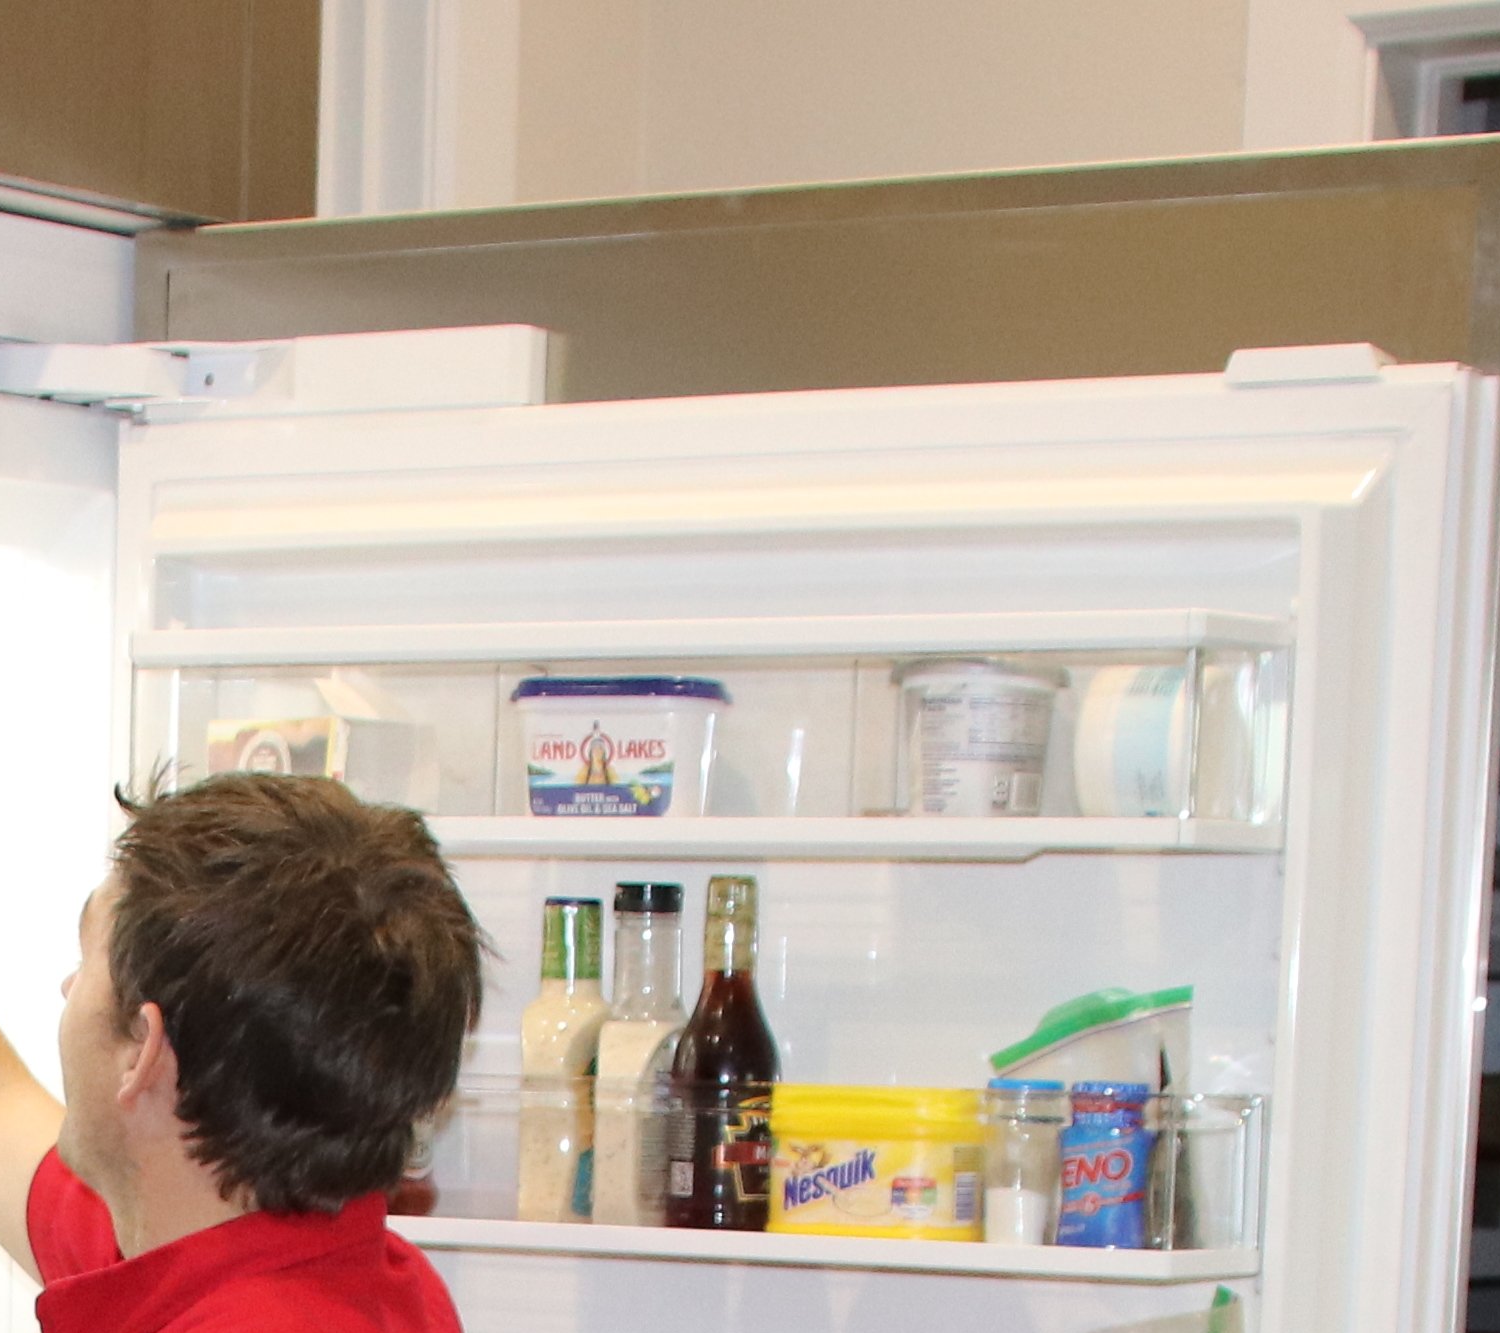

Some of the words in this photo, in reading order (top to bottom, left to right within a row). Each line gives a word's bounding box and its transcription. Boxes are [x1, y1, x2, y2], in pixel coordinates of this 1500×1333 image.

[532, 741, 577, 760] LAND
[617, 738, 667, 759] LAKES
[1063, 1149, 1134, 1189] ENO
